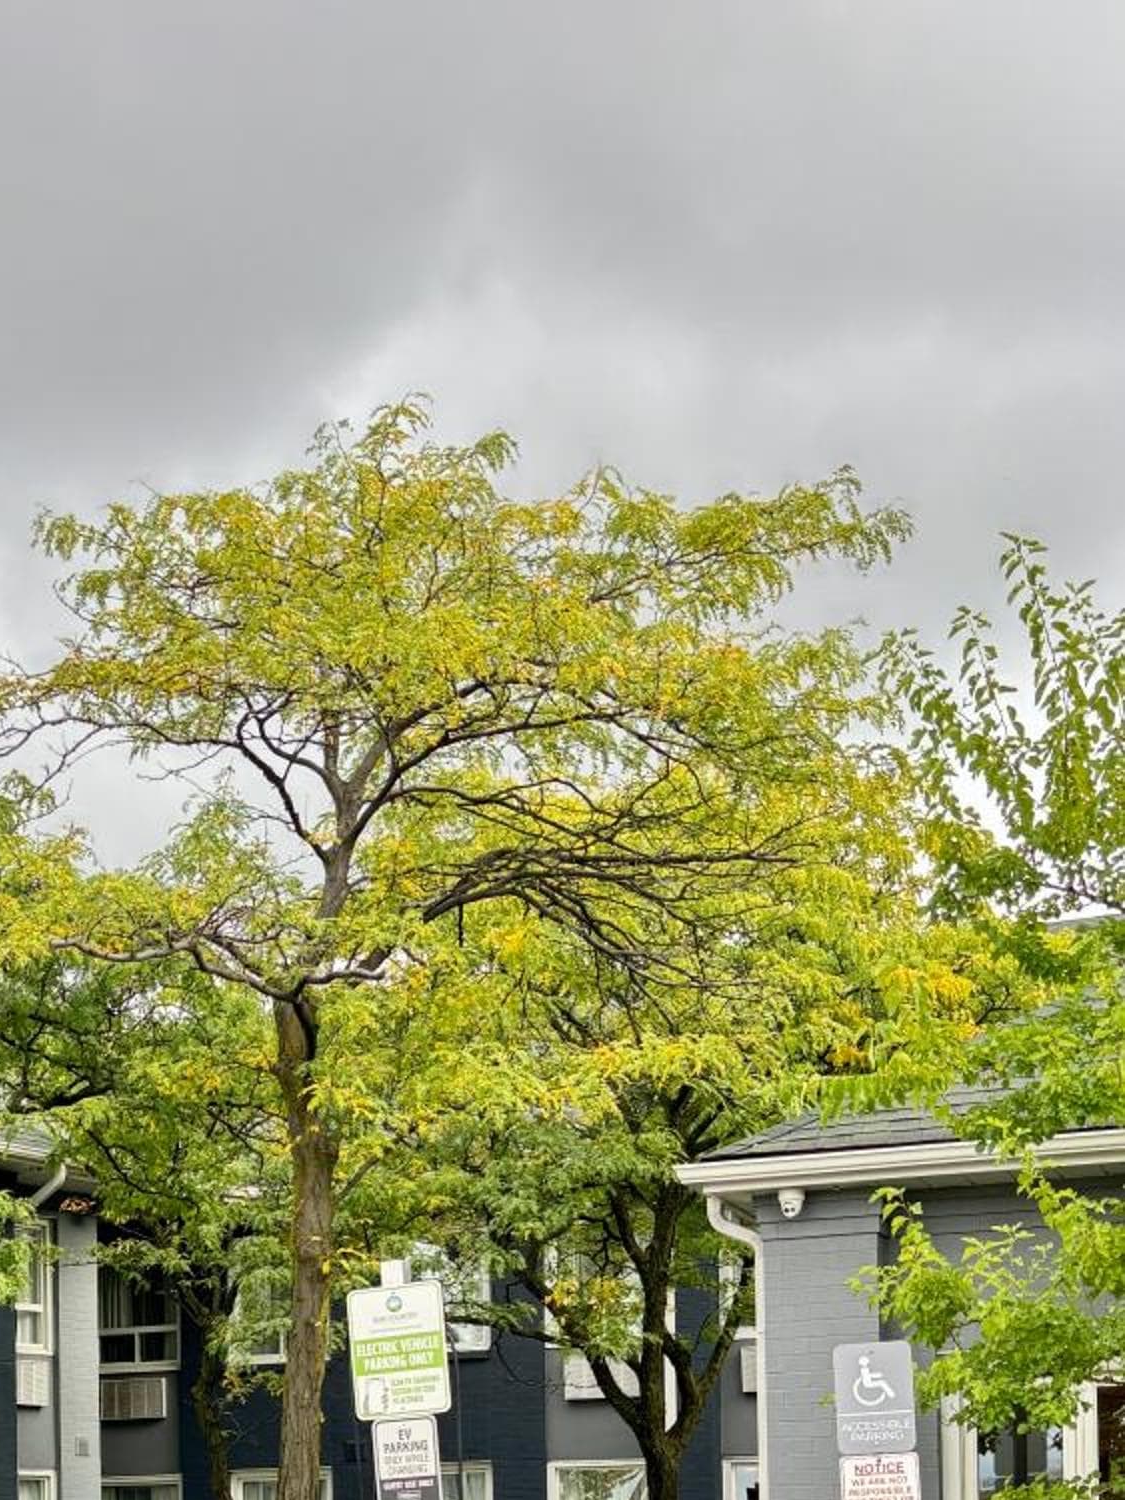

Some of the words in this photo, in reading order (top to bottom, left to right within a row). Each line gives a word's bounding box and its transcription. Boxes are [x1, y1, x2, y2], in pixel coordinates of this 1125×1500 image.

[356, 1340, 393, 1357] ELECTRIC
[401, 1336, 438, 1351] VEHICLE
[364, 1355, 406, 1370] PARKING
[408, 1351, 434, 1365] ONLY
[398, 1428, 412, 1441] EV
[383, 1440, 428, 1454] PARKING
[855, 1461, 905, 1475] NOTICE
[851, 1479, 865, 1487] WE
[868, 1477, 887, 1486] ARE
[889, 1476, 908, 1485] NOT
[848, 1486, 912, 1497] RESPONSIBLE
